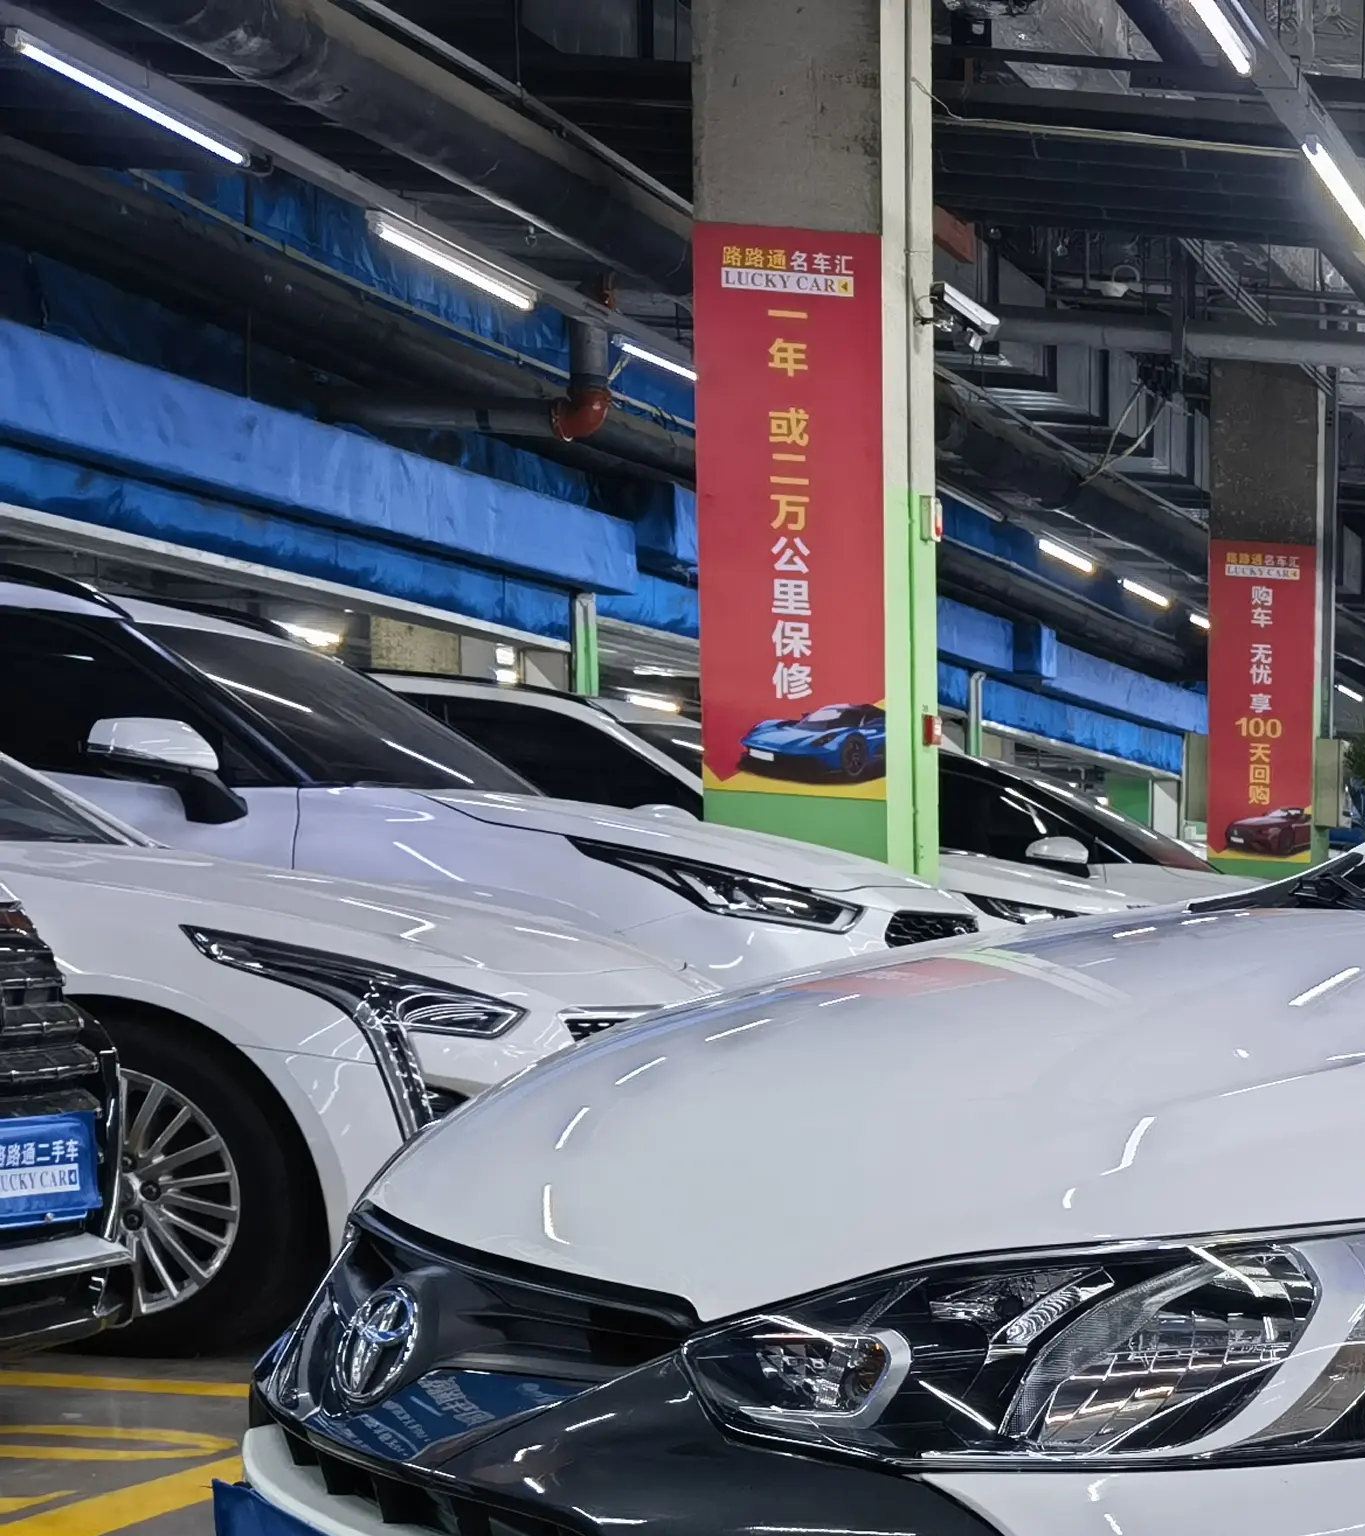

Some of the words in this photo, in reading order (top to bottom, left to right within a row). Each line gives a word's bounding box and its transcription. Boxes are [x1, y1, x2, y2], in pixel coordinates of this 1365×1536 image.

[721, 246, 854, 275] 路路通名车汇
[723, 270, 791, 291] LUCKY
[796, 275, 837, 293] CAR
[1227, 565, 1263, 577] LUCKY
[1267, 568, 1290, 578] CAR
[40, 1169, 67, 1188] CAR
